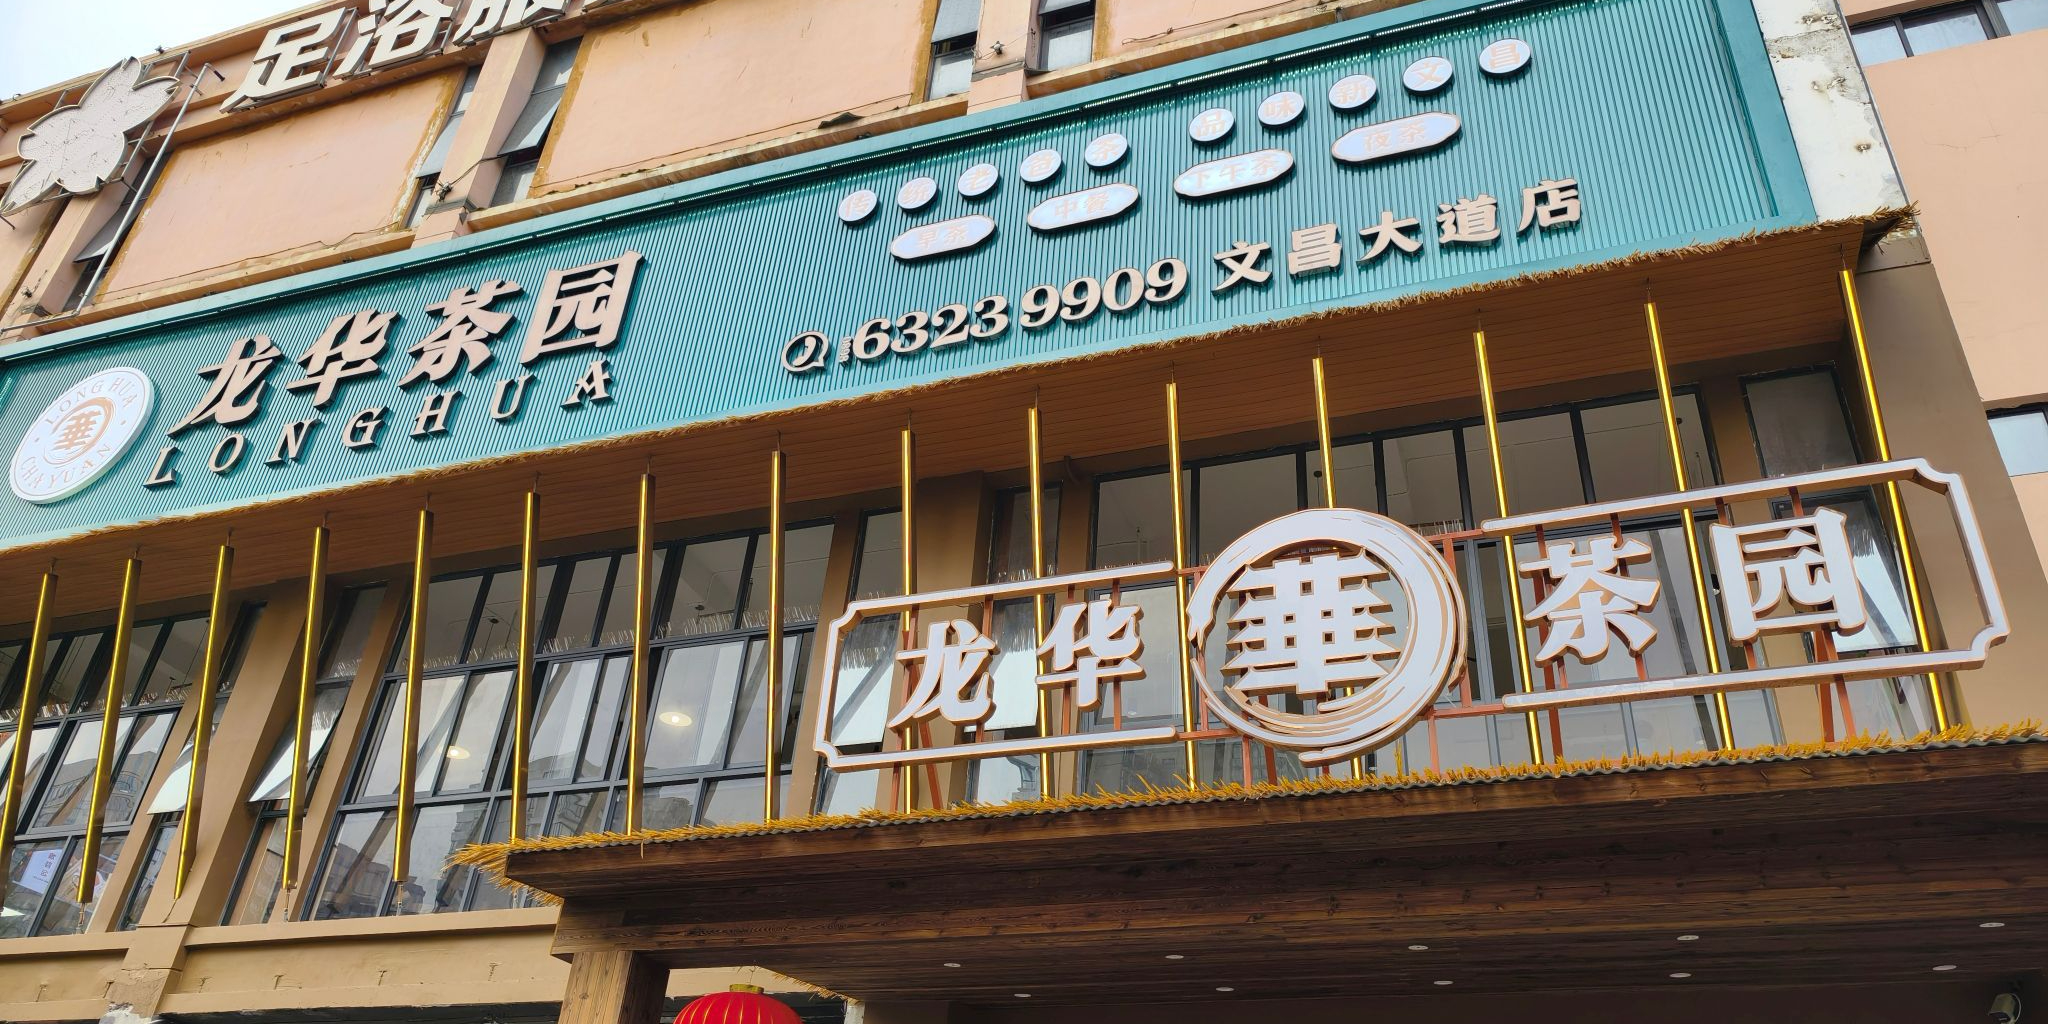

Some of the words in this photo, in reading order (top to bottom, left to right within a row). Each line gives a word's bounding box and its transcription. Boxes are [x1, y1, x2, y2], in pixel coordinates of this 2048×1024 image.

[1195, 43, 1521, 136] 品味新文昌
[843, 137, 1118, 215] 传统老爸茶
[1188, 153, 1280, 187] 下午茶
[1364, 122, 1426, 152] 夜茶
[917, 224, 969, 249] 早茶
[1054, 192, 1111, 220] 中餐
[852, 294, 1009, 361] 6323
[1020, 257, 1188, 330] 9909
[1212, 177, 1582, 294] 文昌大道店
[168, 250, 643, 437] 龙华茶园
[51, 410, 102, 450] 華
[144, 359, 613, 487] LONGHUA
[889, 599, 1147, 729] 龙华
[1221, 547, 1400, 699] 華
[1518, 506, 1867, 668] 茶园
